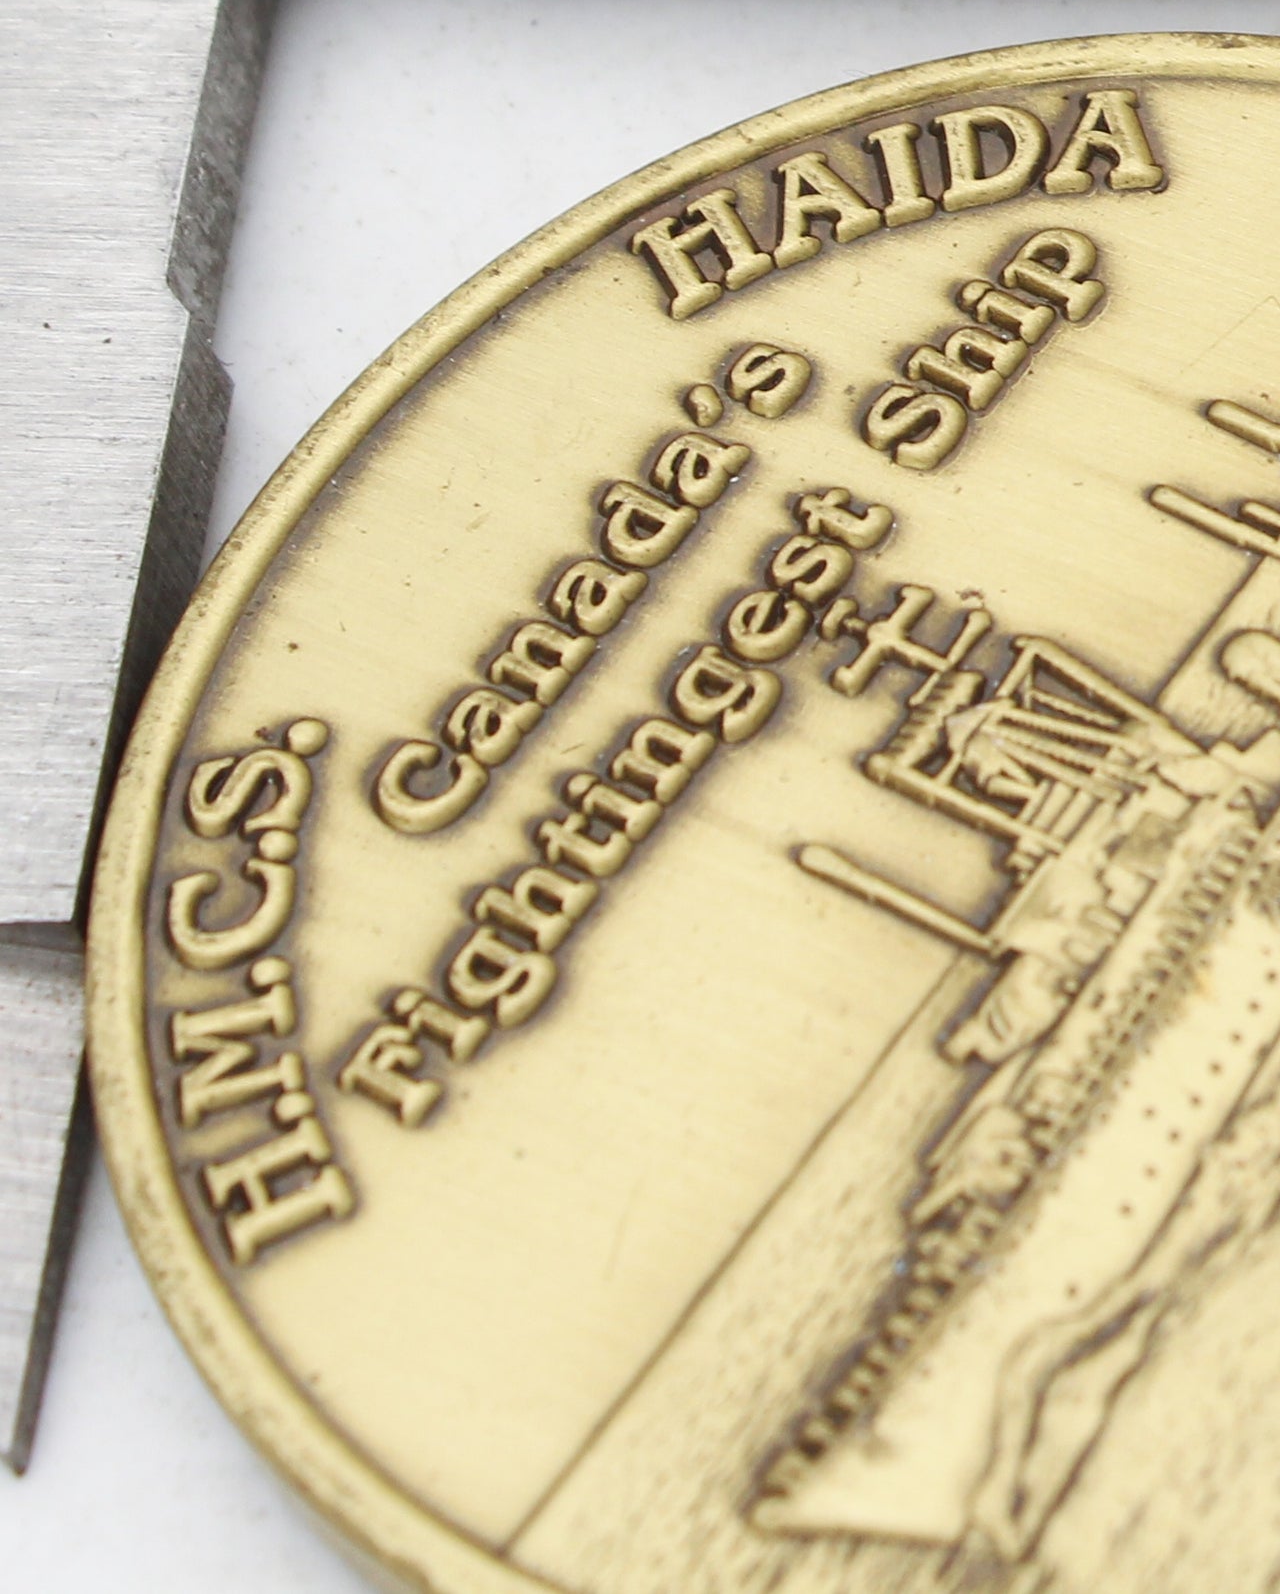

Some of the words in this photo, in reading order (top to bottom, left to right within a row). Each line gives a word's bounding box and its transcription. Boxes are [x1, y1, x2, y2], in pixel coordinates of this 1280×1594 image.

[167, 717, 357, 1265] H.M.C.S.
[629, 88, 1168, 321] HAIDA
[338, 486, 895, 1129] Fightingest
[862, 226, 1107, 472] Ship
[374, 341, 813, 835] Canada's
